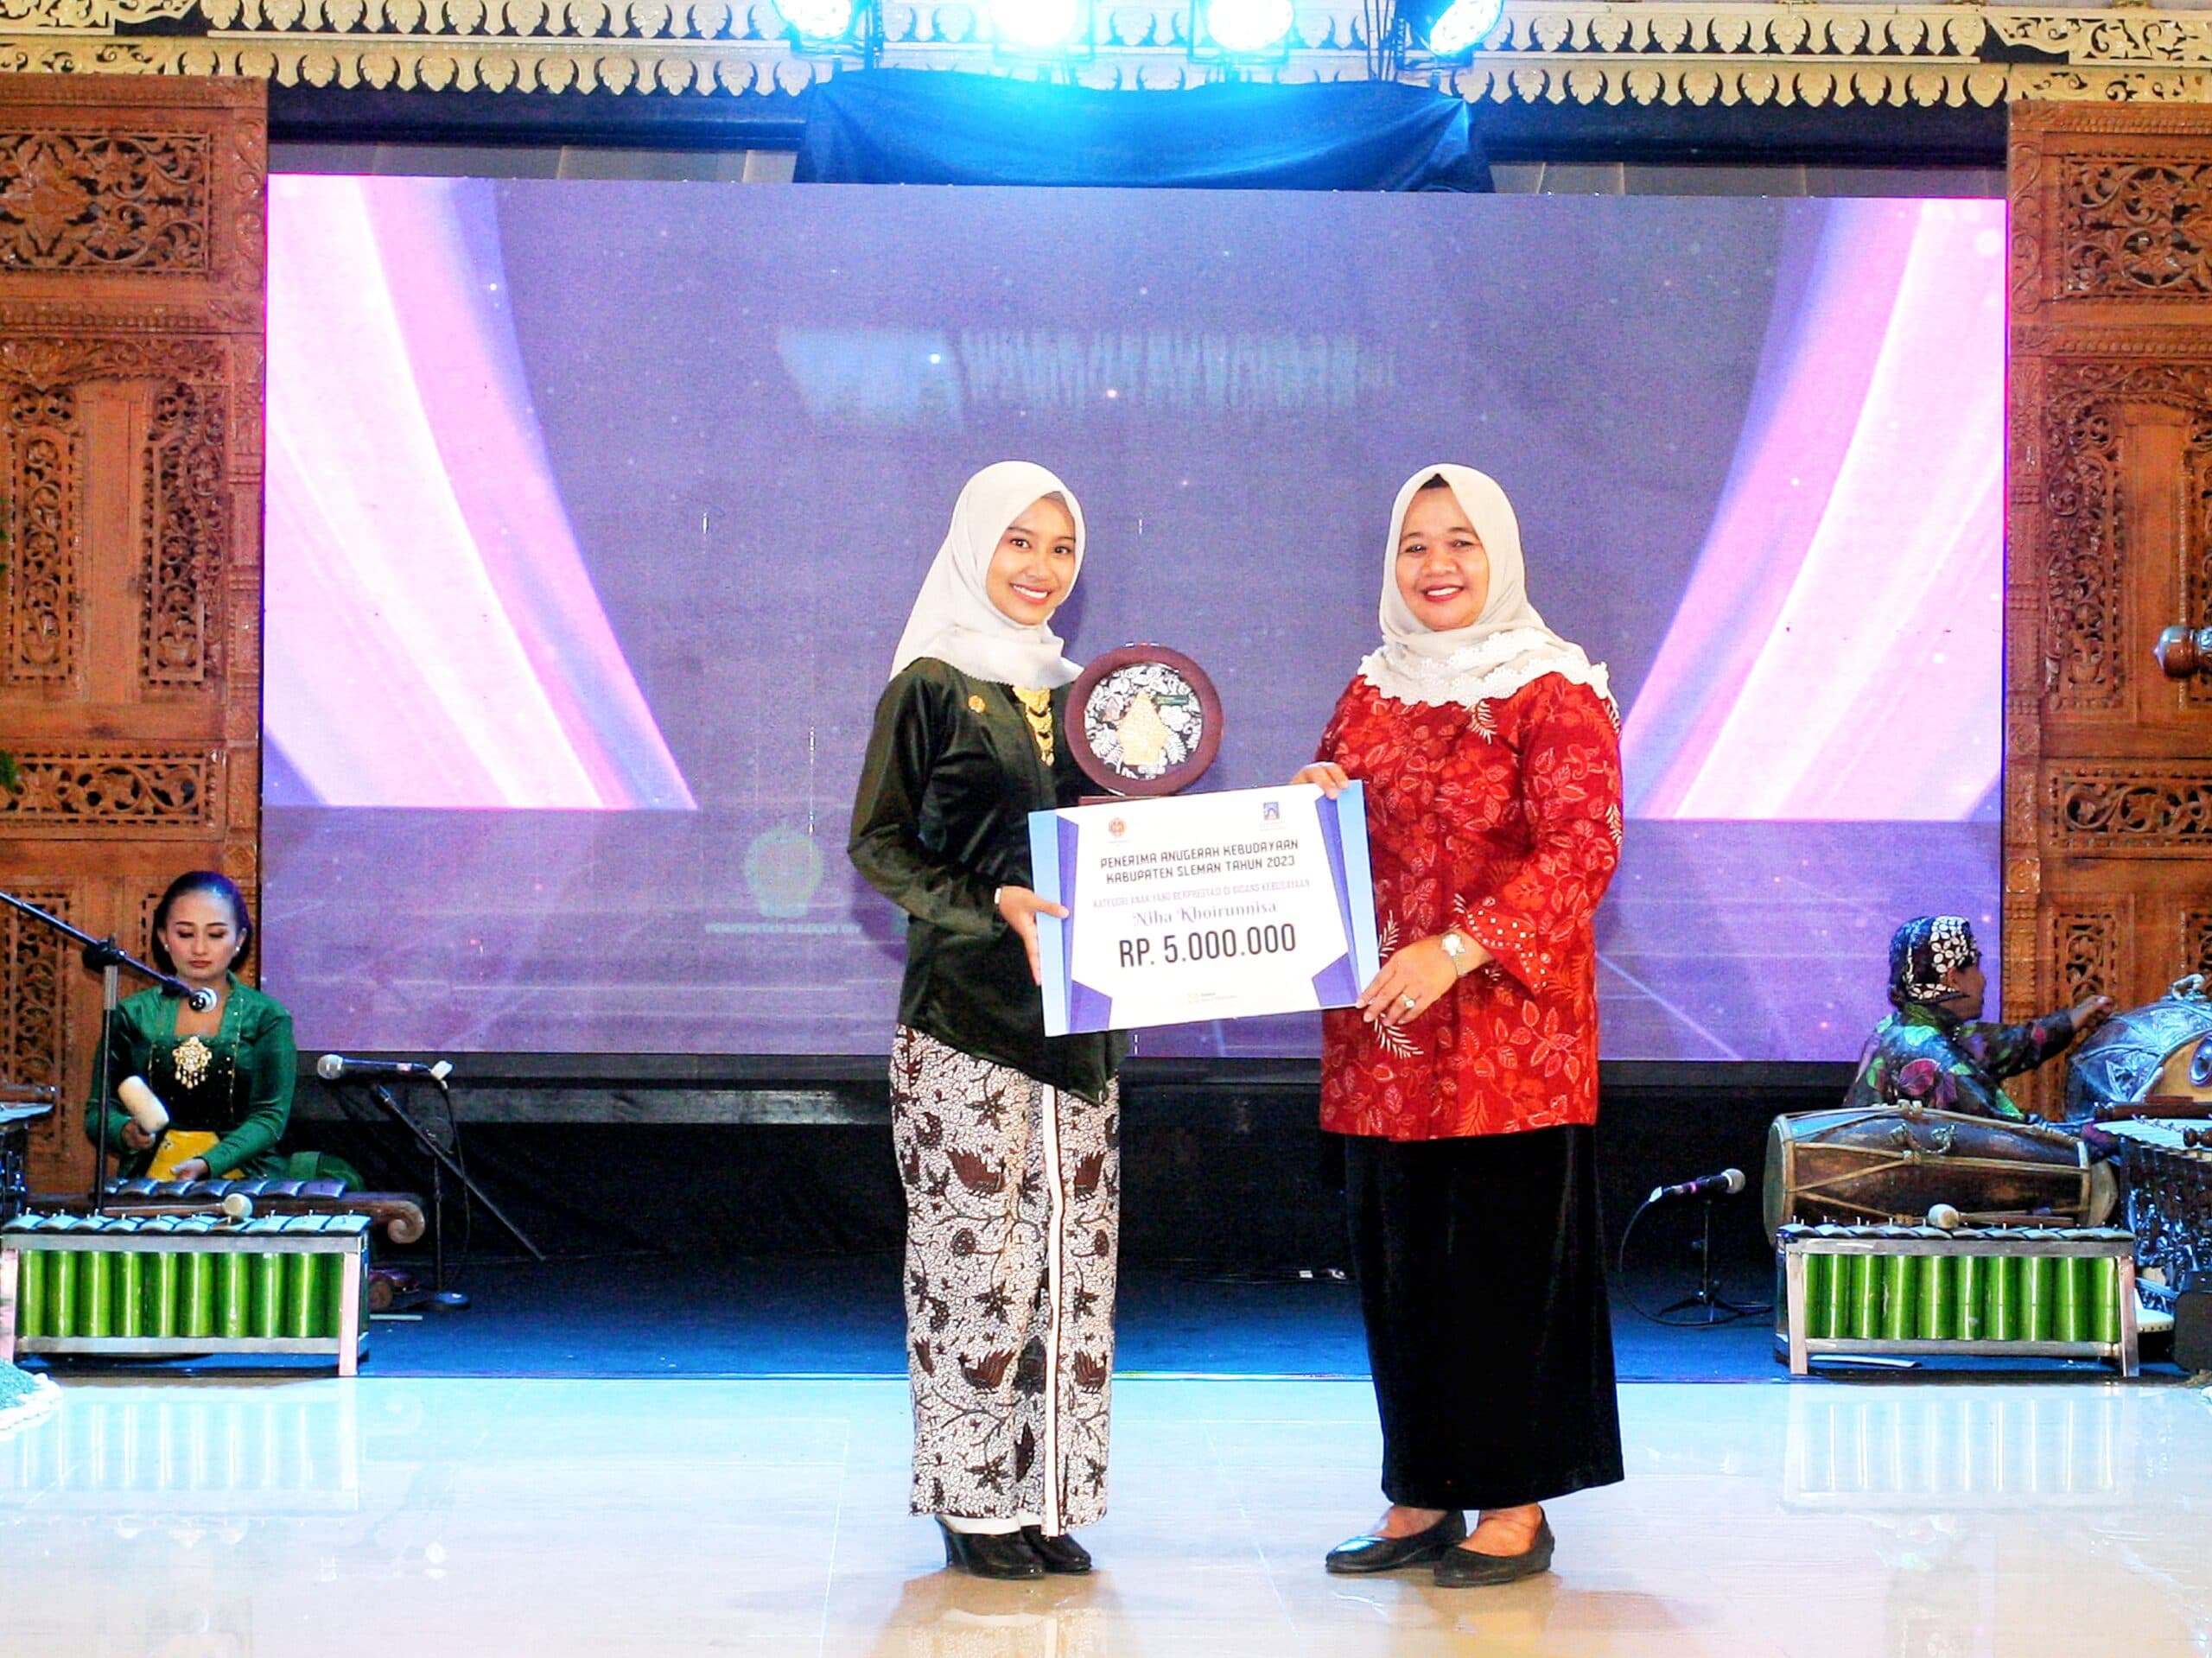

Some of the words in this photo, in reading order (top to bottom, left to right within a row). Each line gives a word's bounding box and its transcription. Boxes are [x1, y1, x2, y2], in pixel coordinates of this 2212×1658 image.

[1100, 853, 1157, 868] PENERIMA
[1160, 846, 1220, 862] ANUGERAH
[1224, 838, 1299, 855] KEBUDAYAAN
[1106, 867, 1173, 885] KABUPATEN
[1177, 861, 1222, 877] SLEMAN
[1225, 857, 1262, 872] TAHUN
[1266, 855, 1295, 868] 2023
[1118, 938, 1155, 968] RP.
[1164, 923, 1296, 963] 5.000.000
